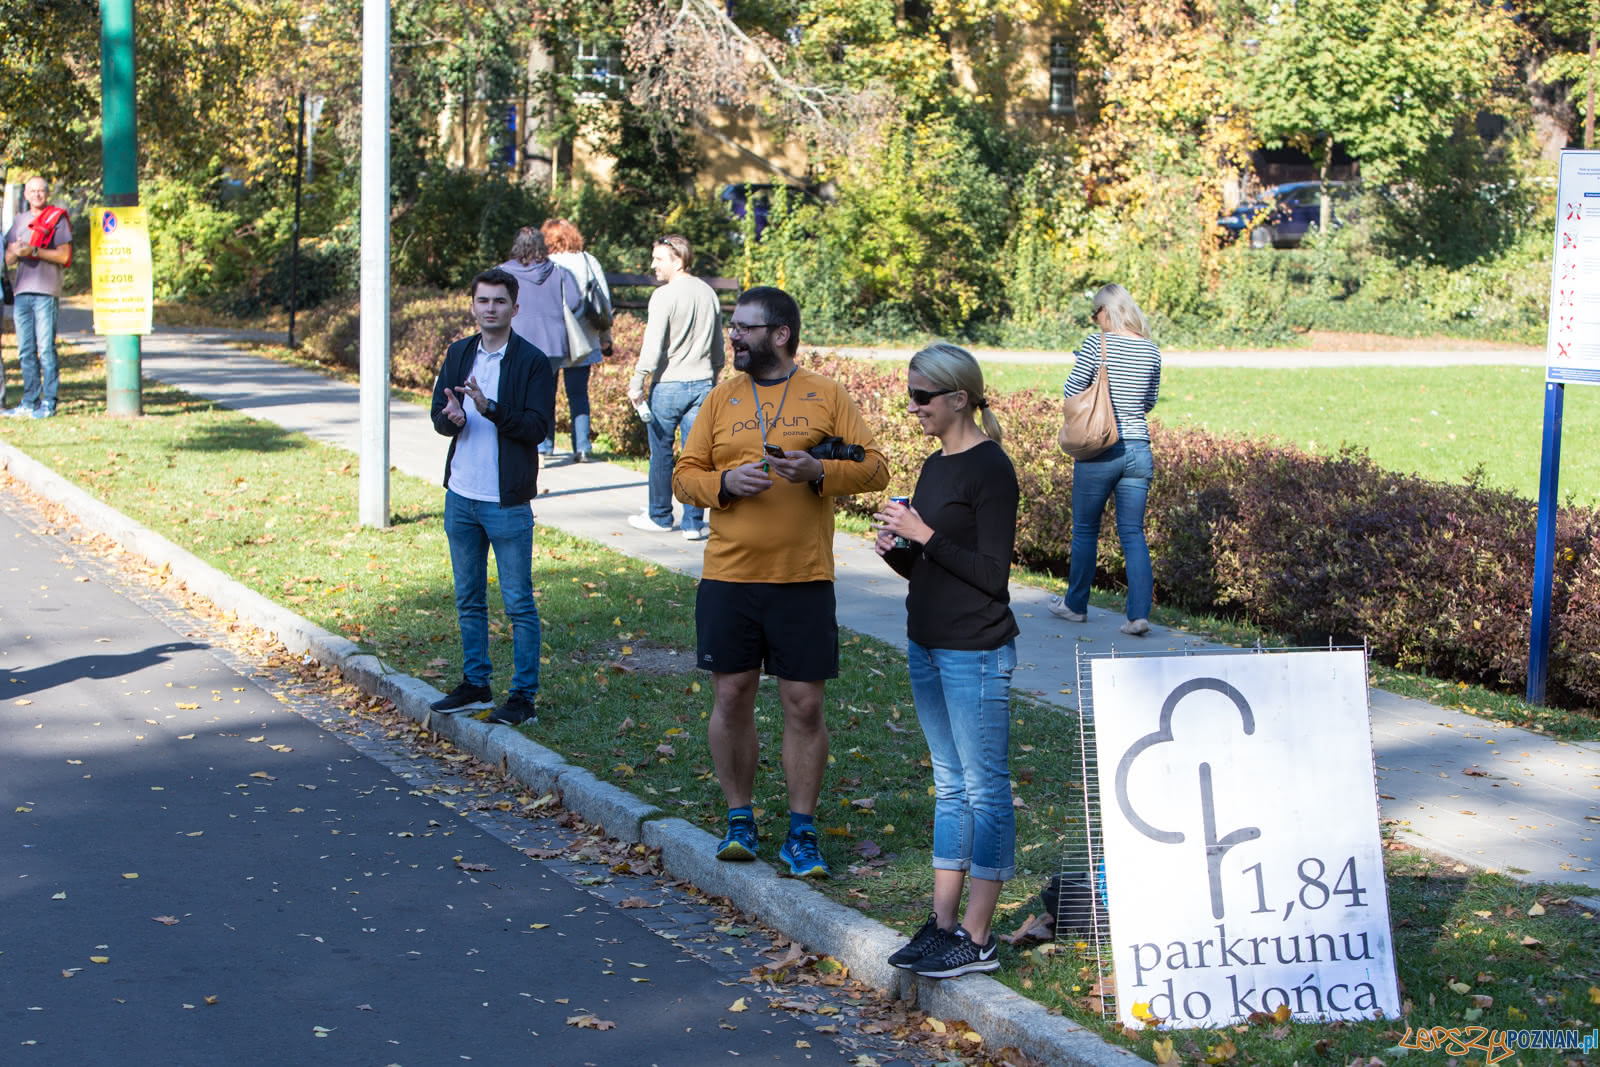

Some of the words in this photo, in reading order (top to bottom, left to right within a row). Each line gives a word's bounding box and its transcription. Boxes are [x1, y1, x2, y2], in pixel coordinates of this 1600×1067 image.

[1242, 856, 1369, 922] 1,84
[1129, 924, 1375, 987] parkrunu
[1148, 979, 1212, 1021] do
[1226, 973, 1382, 1018] końca
